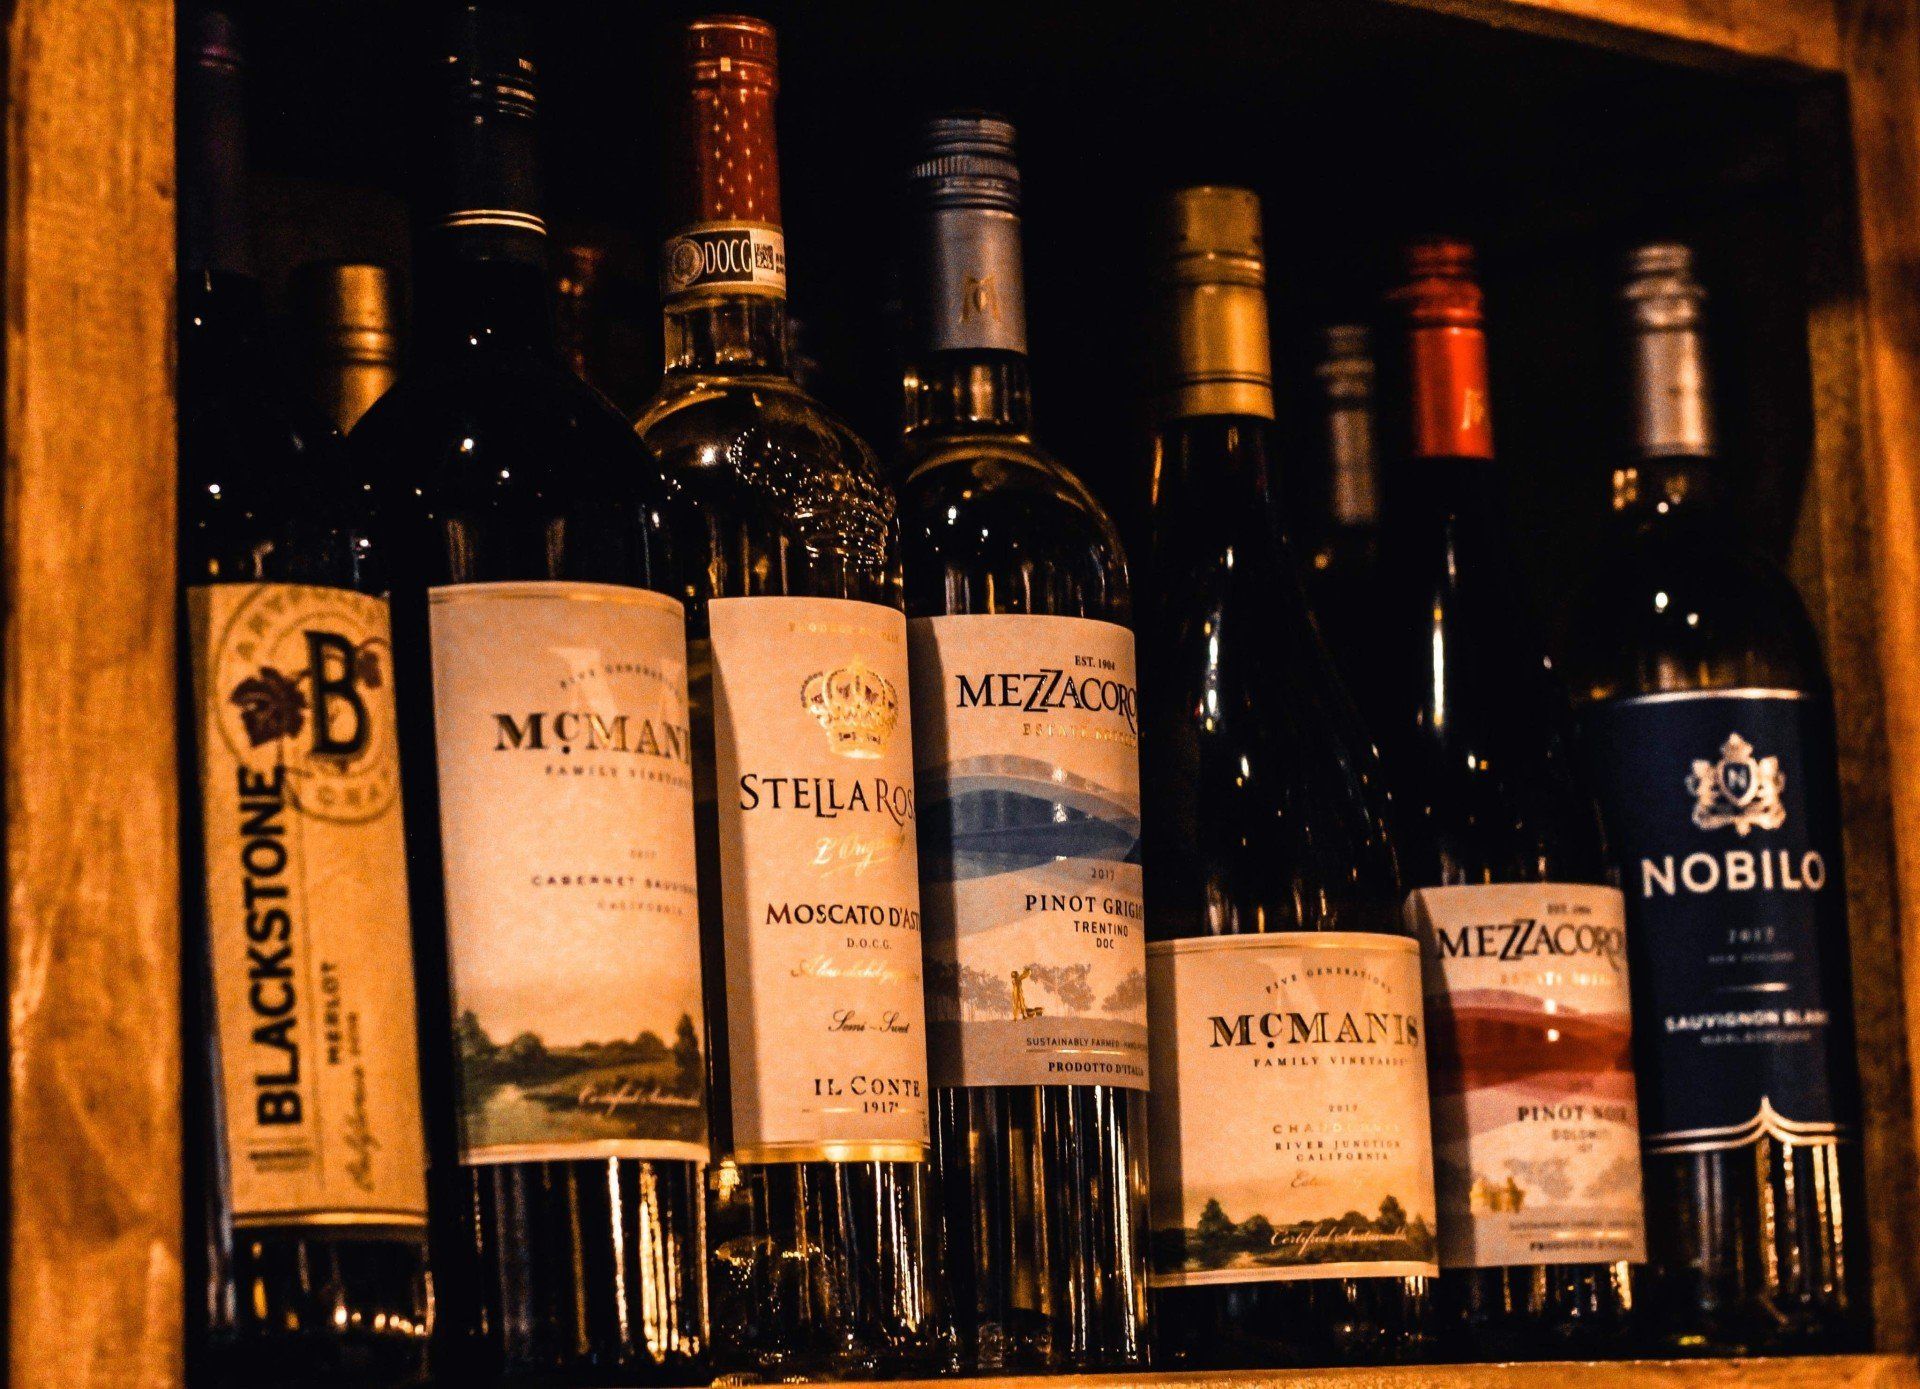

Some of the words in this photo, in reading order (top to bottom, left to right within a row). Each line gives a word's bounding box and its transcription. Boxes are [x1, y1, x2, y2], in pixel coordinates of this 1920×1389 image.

[704, 239, 752, 274] DOCG
[1074, 655, 1096, 668] EST.
[739, 773, 870, 819] STELLA
[874, 777, 917, 827] ROS
[1641, 850, 1827, 898] NOBILO
[1026, 895, 1097, 913] PINOT
[766, 902, 884, 926] MOSCATO
[1074, 920, 1129, 938] TRENTINO
[238, 764, 303, 1126] BLACKSTONE
[1096, 938, 1115, 950] DOC
[1026, 1037, 1089, 1047] SUSTAINABLY
[1048, 1061, 1112, 1074] PRODOTTO
[1253, 1056, 1319, 1068] FAMILY
[850, 1075, 921, 1099] CONTE
[1518, 1104, 1584, 1122] PINOT
[1275, 1141, 1324, 1151] RIVER
[1296, 1153, 1388, 1162] CALIFORNIA
